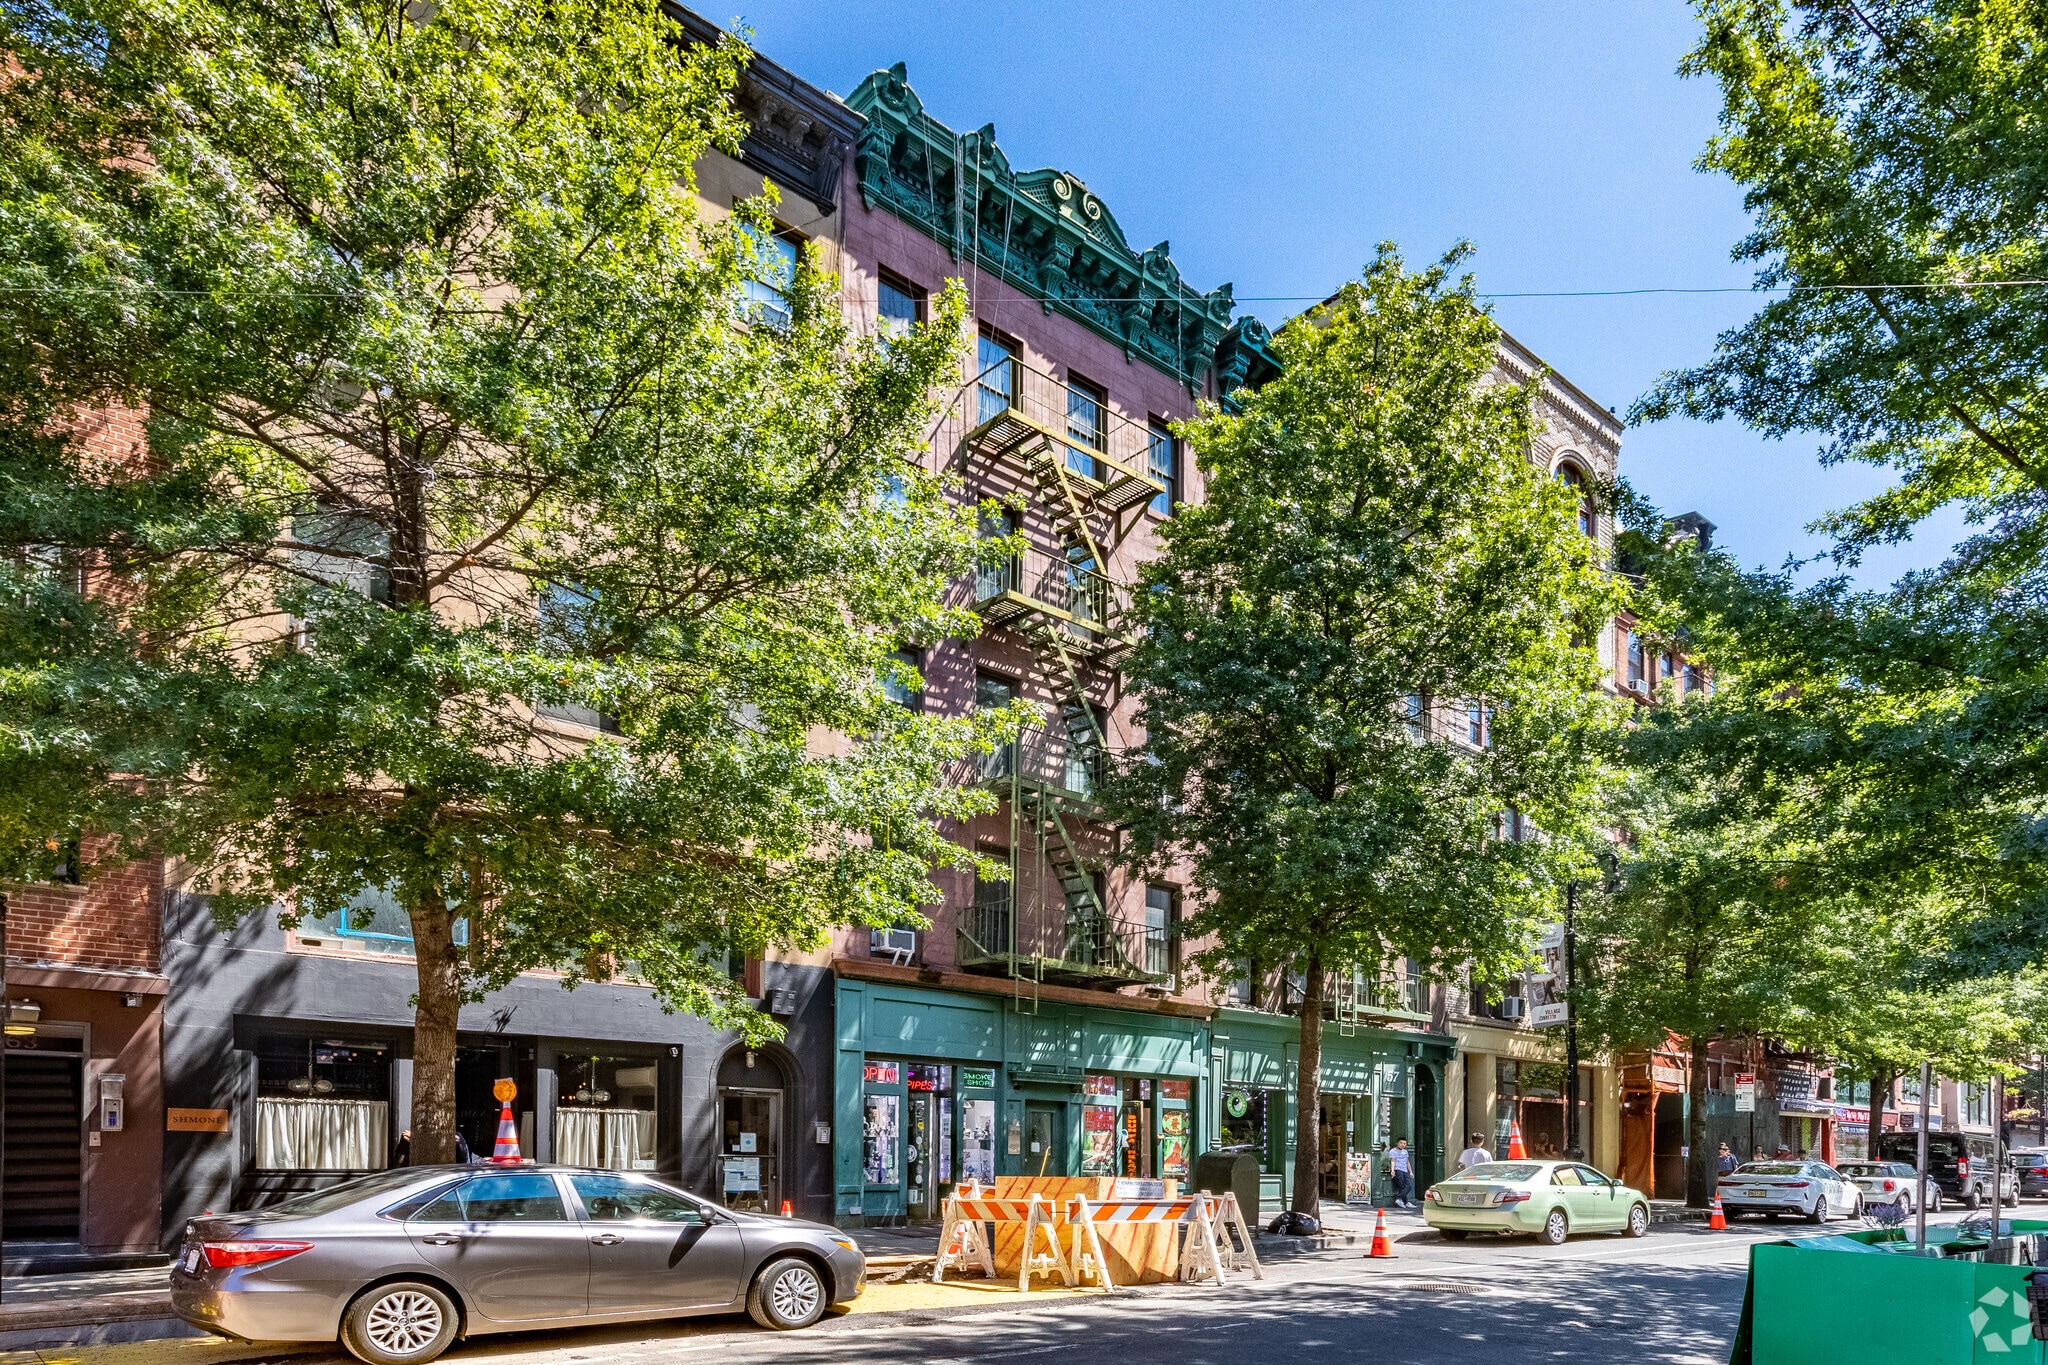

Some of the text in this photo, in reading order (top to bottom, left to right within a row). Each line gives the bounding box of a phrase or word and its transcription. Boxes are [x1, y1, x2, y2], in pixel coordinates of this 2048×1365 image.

[963, 1072, 992, 1081] SMOKE
[1386, 1071, 1400, 1083] 57
[906, 1080, 934, 1090] PIPES
[172, 1116, 224, 1124] SHMONÉ
